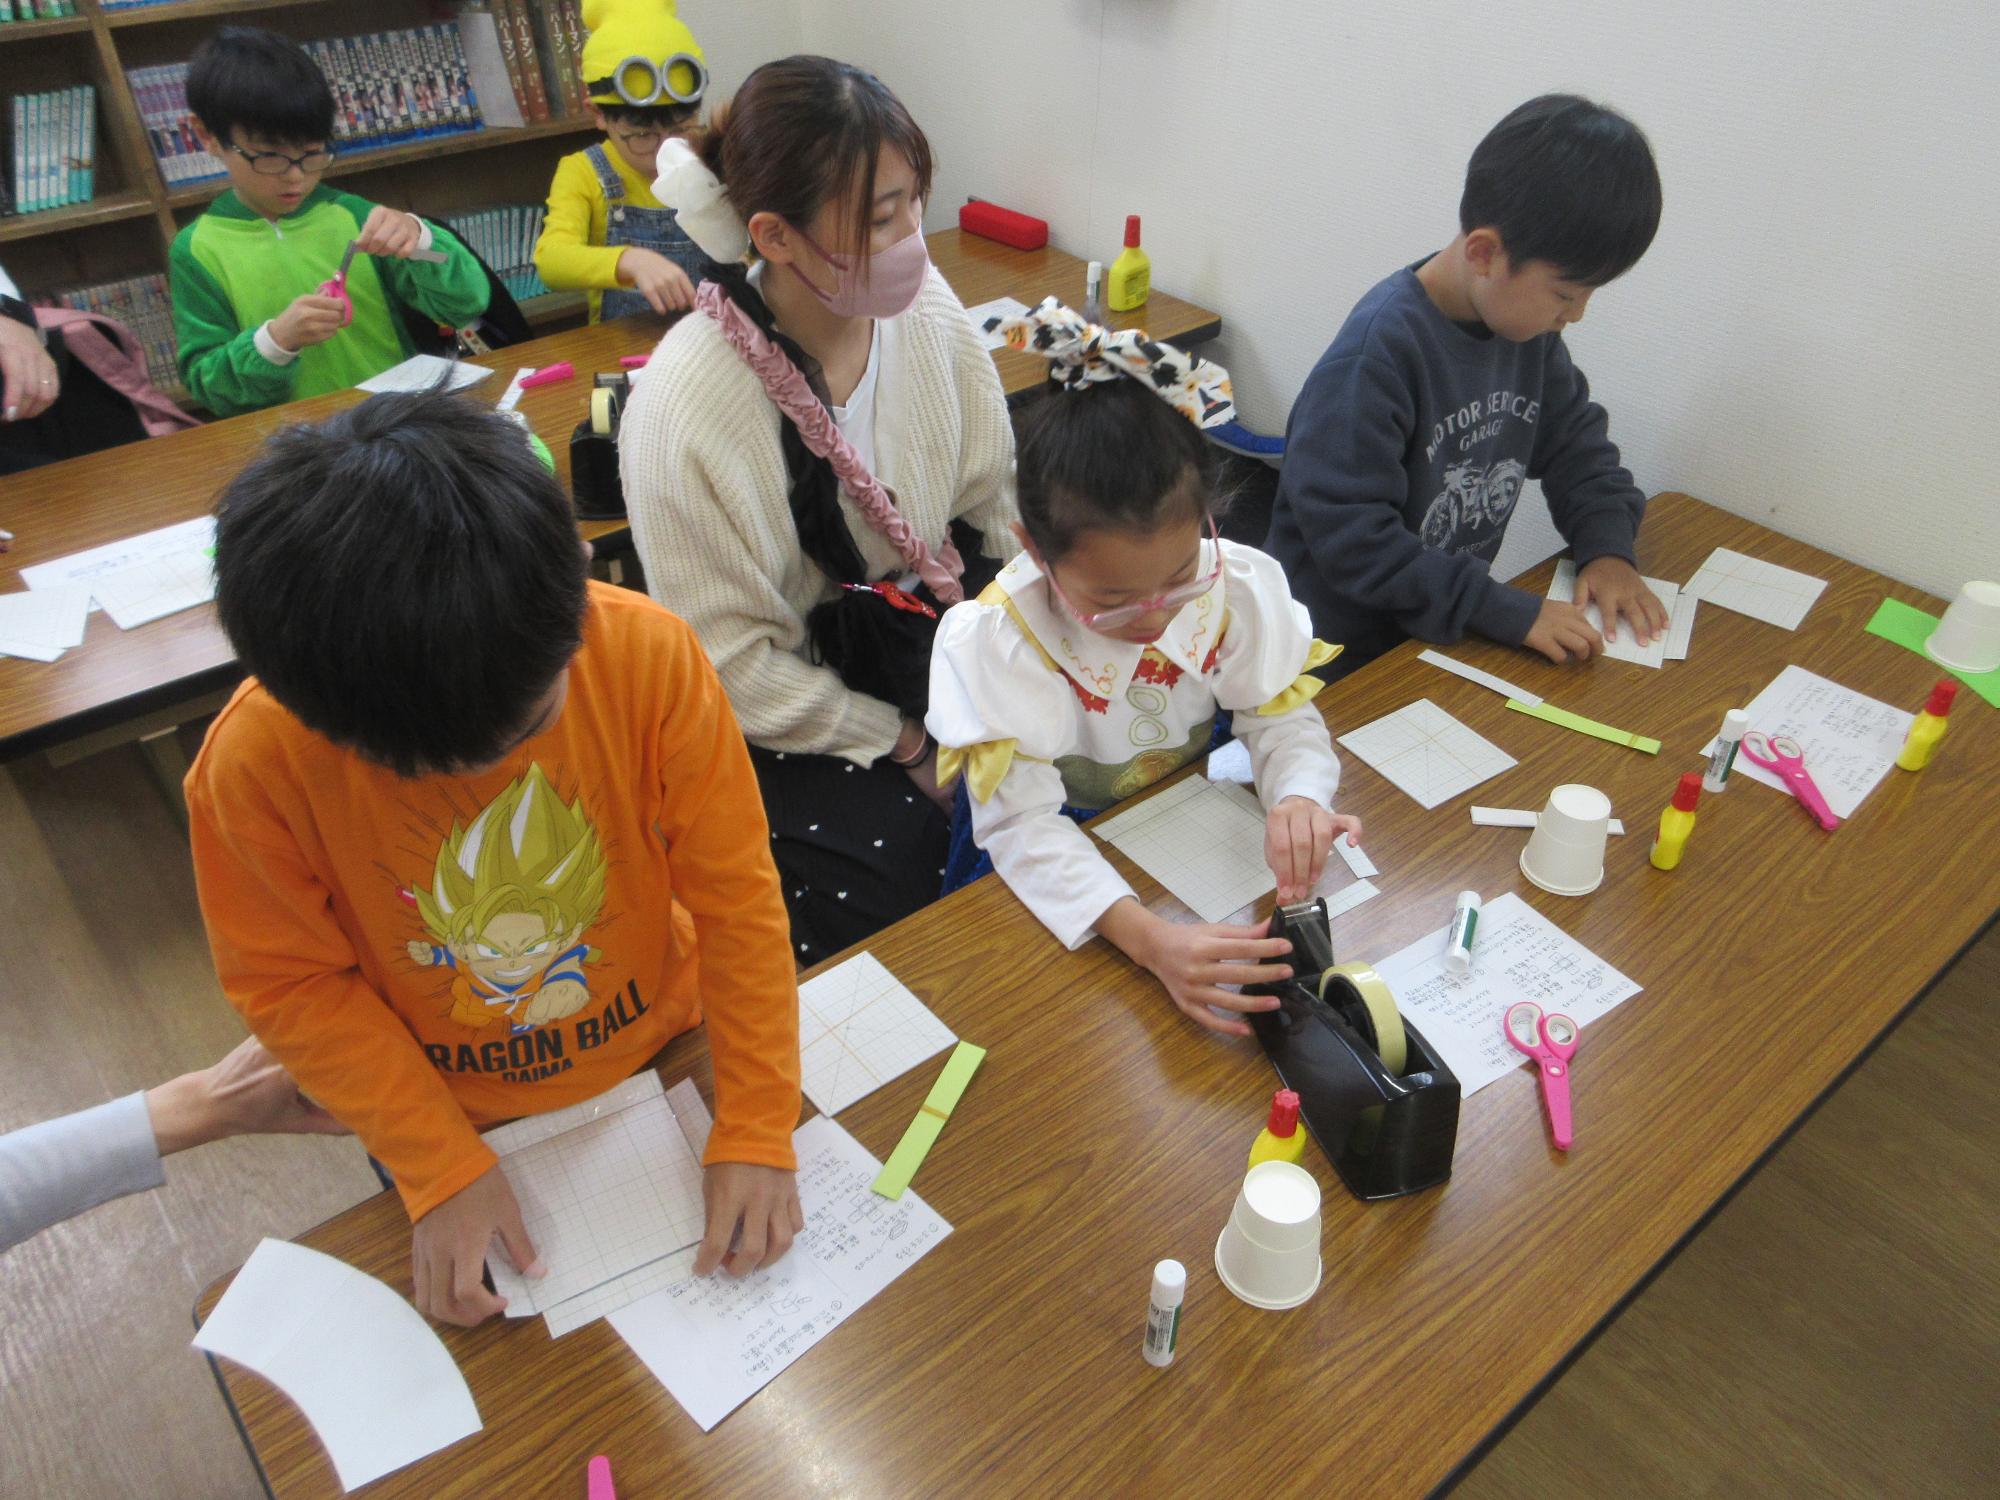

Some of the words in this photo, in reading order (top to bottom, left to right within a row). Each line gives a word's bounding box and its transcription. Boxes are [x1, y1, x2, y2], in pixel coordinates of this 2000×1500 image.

[1425, 401, 1483, 464] MOTOR
[1486, 391, 1541, 424] SERCE
[1459, 419, 1503, 452] GARAG
[424, 1028, 564, 1073] RAGON
[575, 978, 650, 1051] BALL
